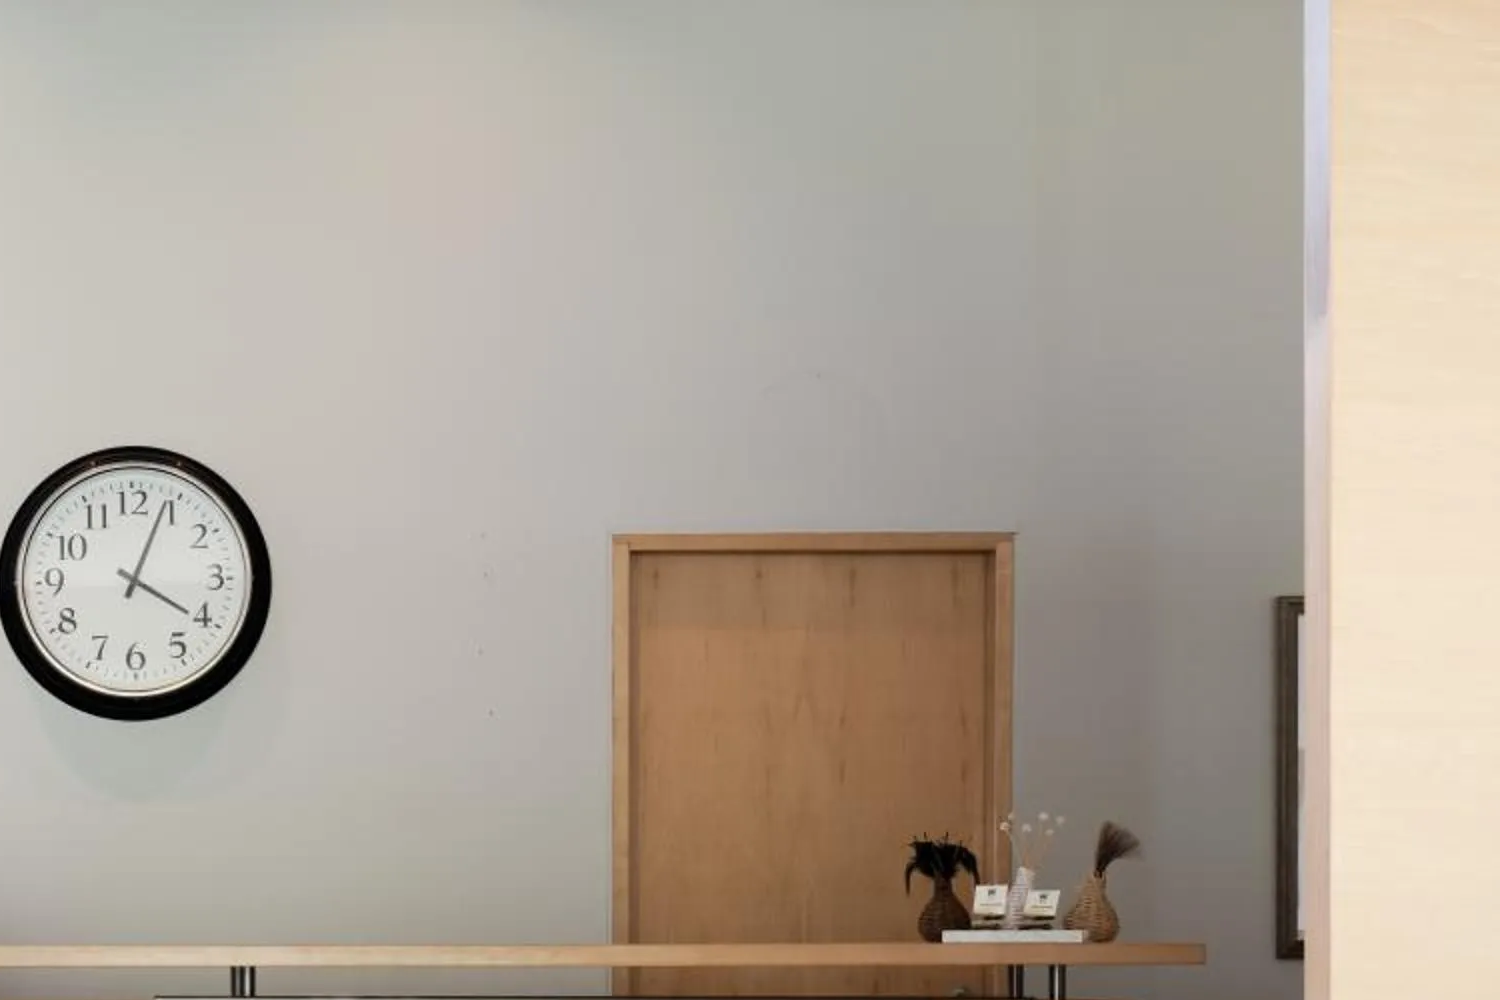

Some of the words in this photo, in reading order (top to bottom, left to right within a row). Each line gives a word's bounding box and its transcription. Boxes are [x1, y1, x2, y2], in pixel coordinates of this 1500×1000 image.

[86, 503, 108, 530] 11
[116, 491, 149, 516] 12
[166, 500, 175, 526] 1
[58, 533, 87, 561] 10
[190, 524, 209, 549] 2
[45, 568, 65, 597] 9
[208, 564, 225, 591] 3
[58, 607, 78, 633] 8
[193, 602, 212, 628] 4
[91, 635, 109, 660] 7
[125, 642, 146, 670] 6
[169, 632, 187, 658] 5
